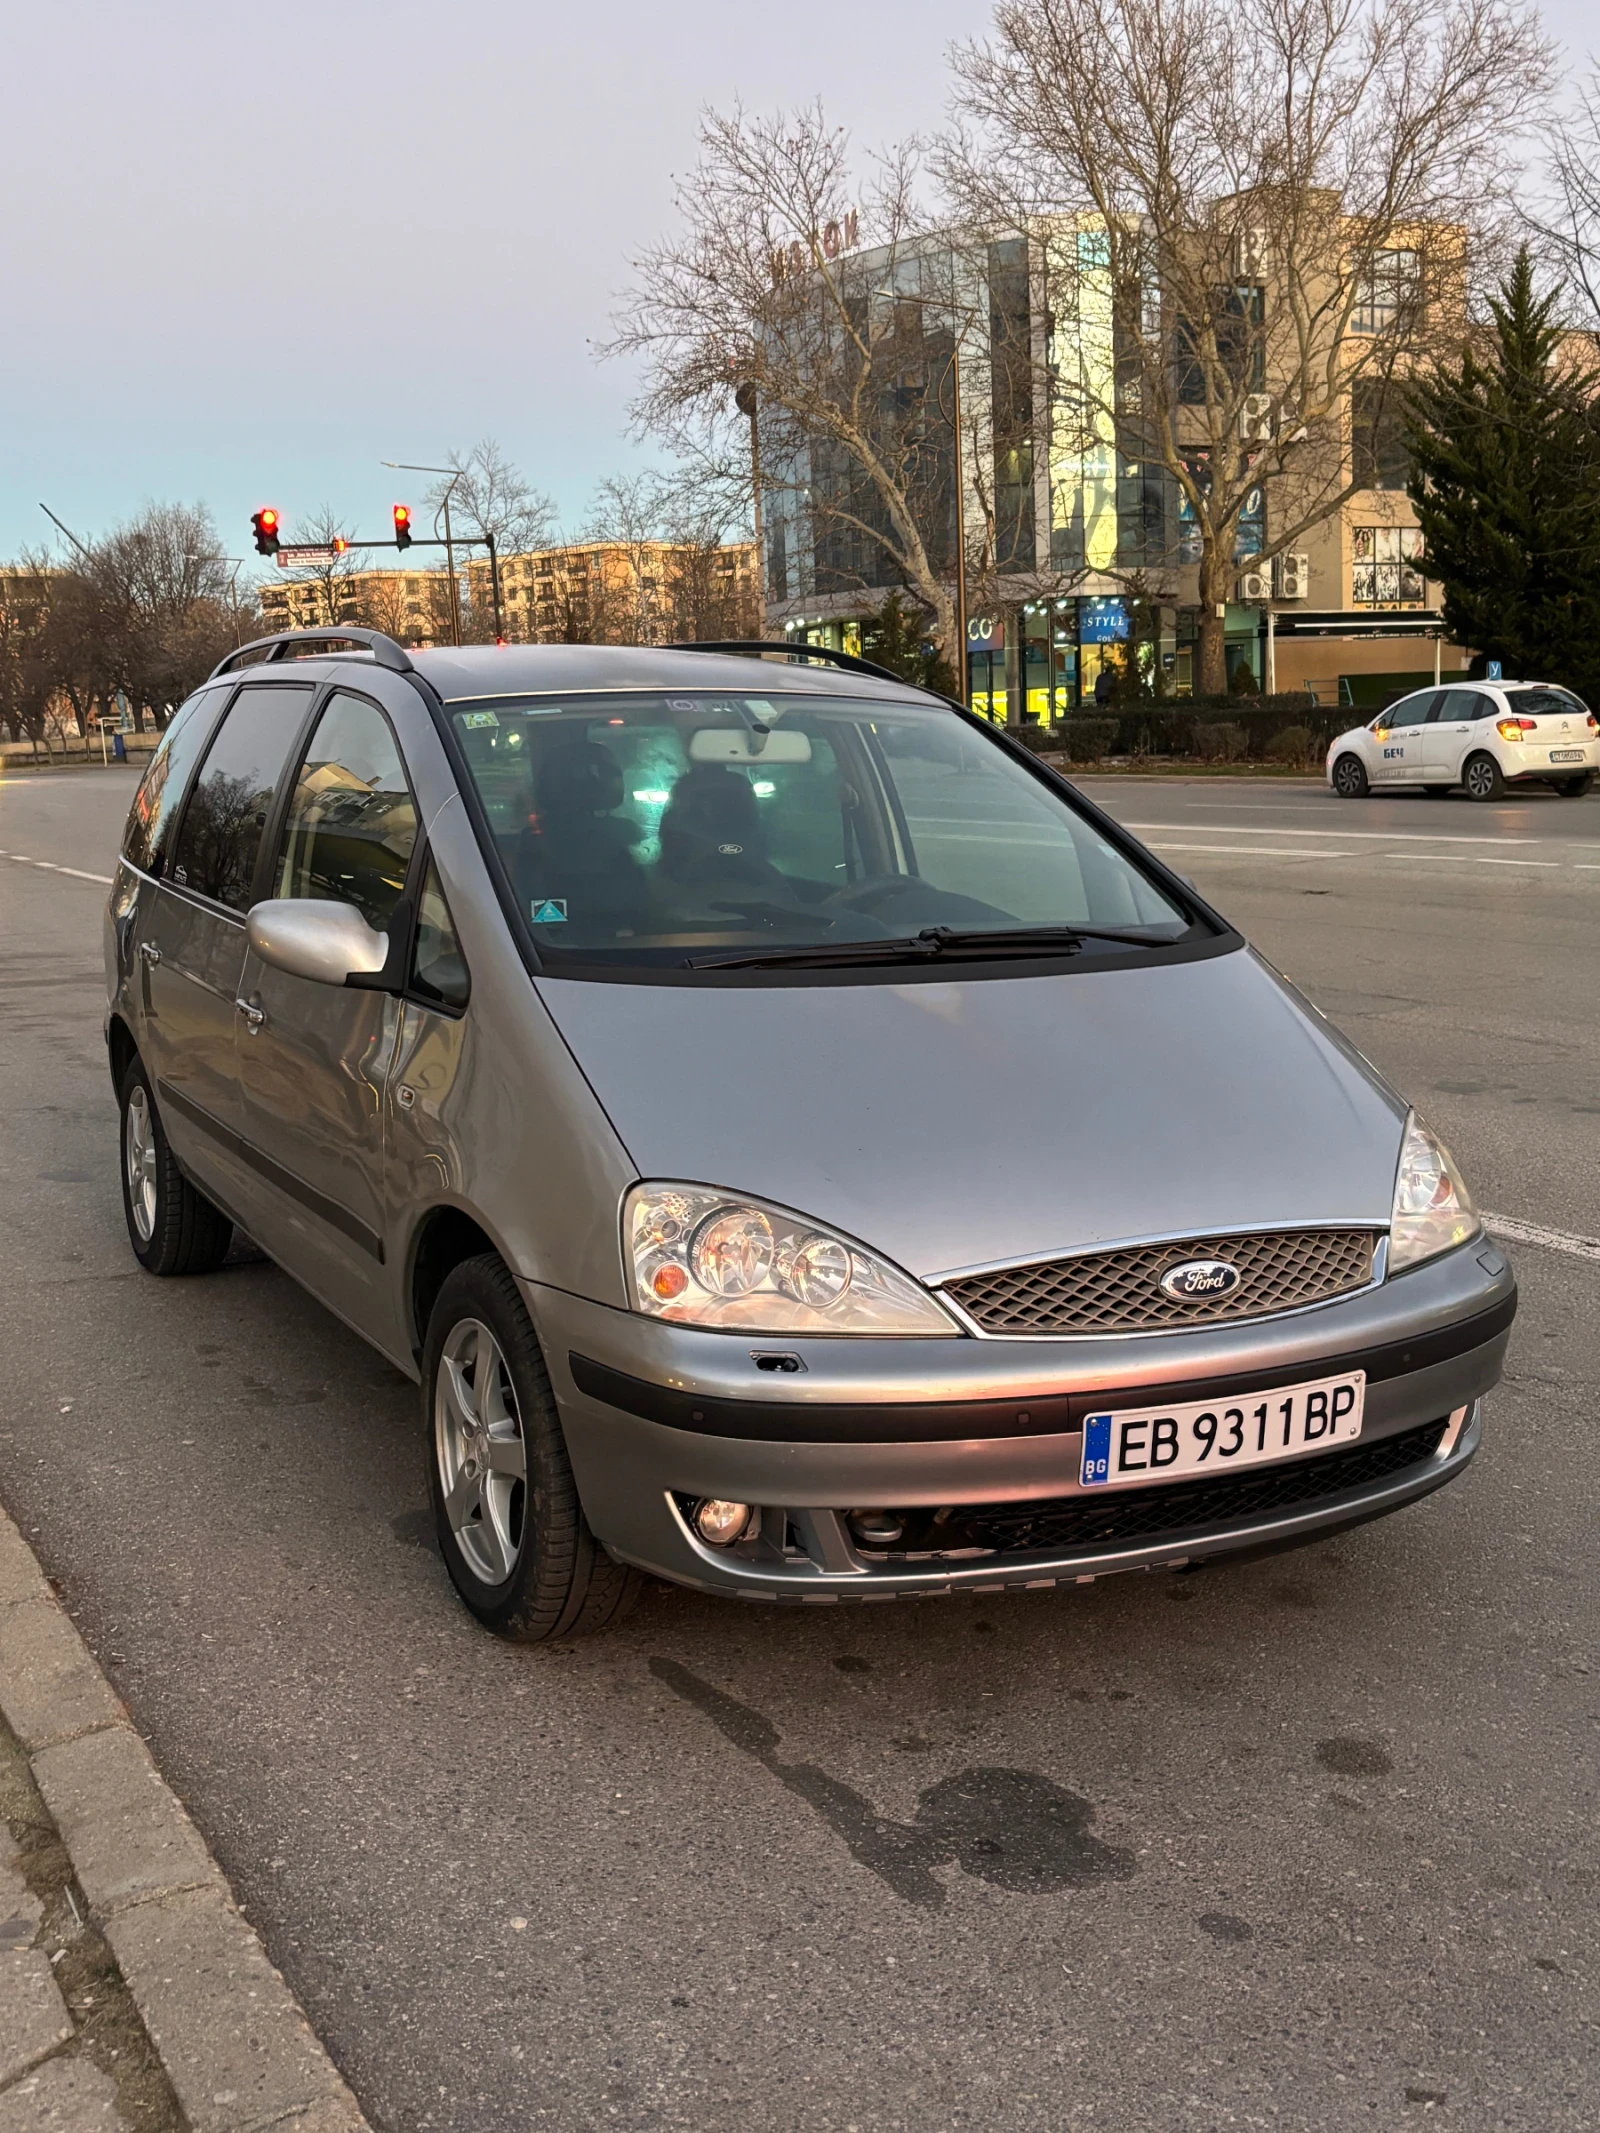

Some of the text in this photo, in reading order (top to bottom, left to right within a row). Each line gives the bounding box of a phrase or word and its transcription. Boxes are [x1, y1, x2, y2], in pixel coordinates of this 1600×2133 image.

[1087, 616, 1125, 627] STYLE
[1184, 1270, 1225, 1292] Ford
[1193, 1397, 1293, 1462] 9311
[1085, 1459, 1107, 1475] BG
